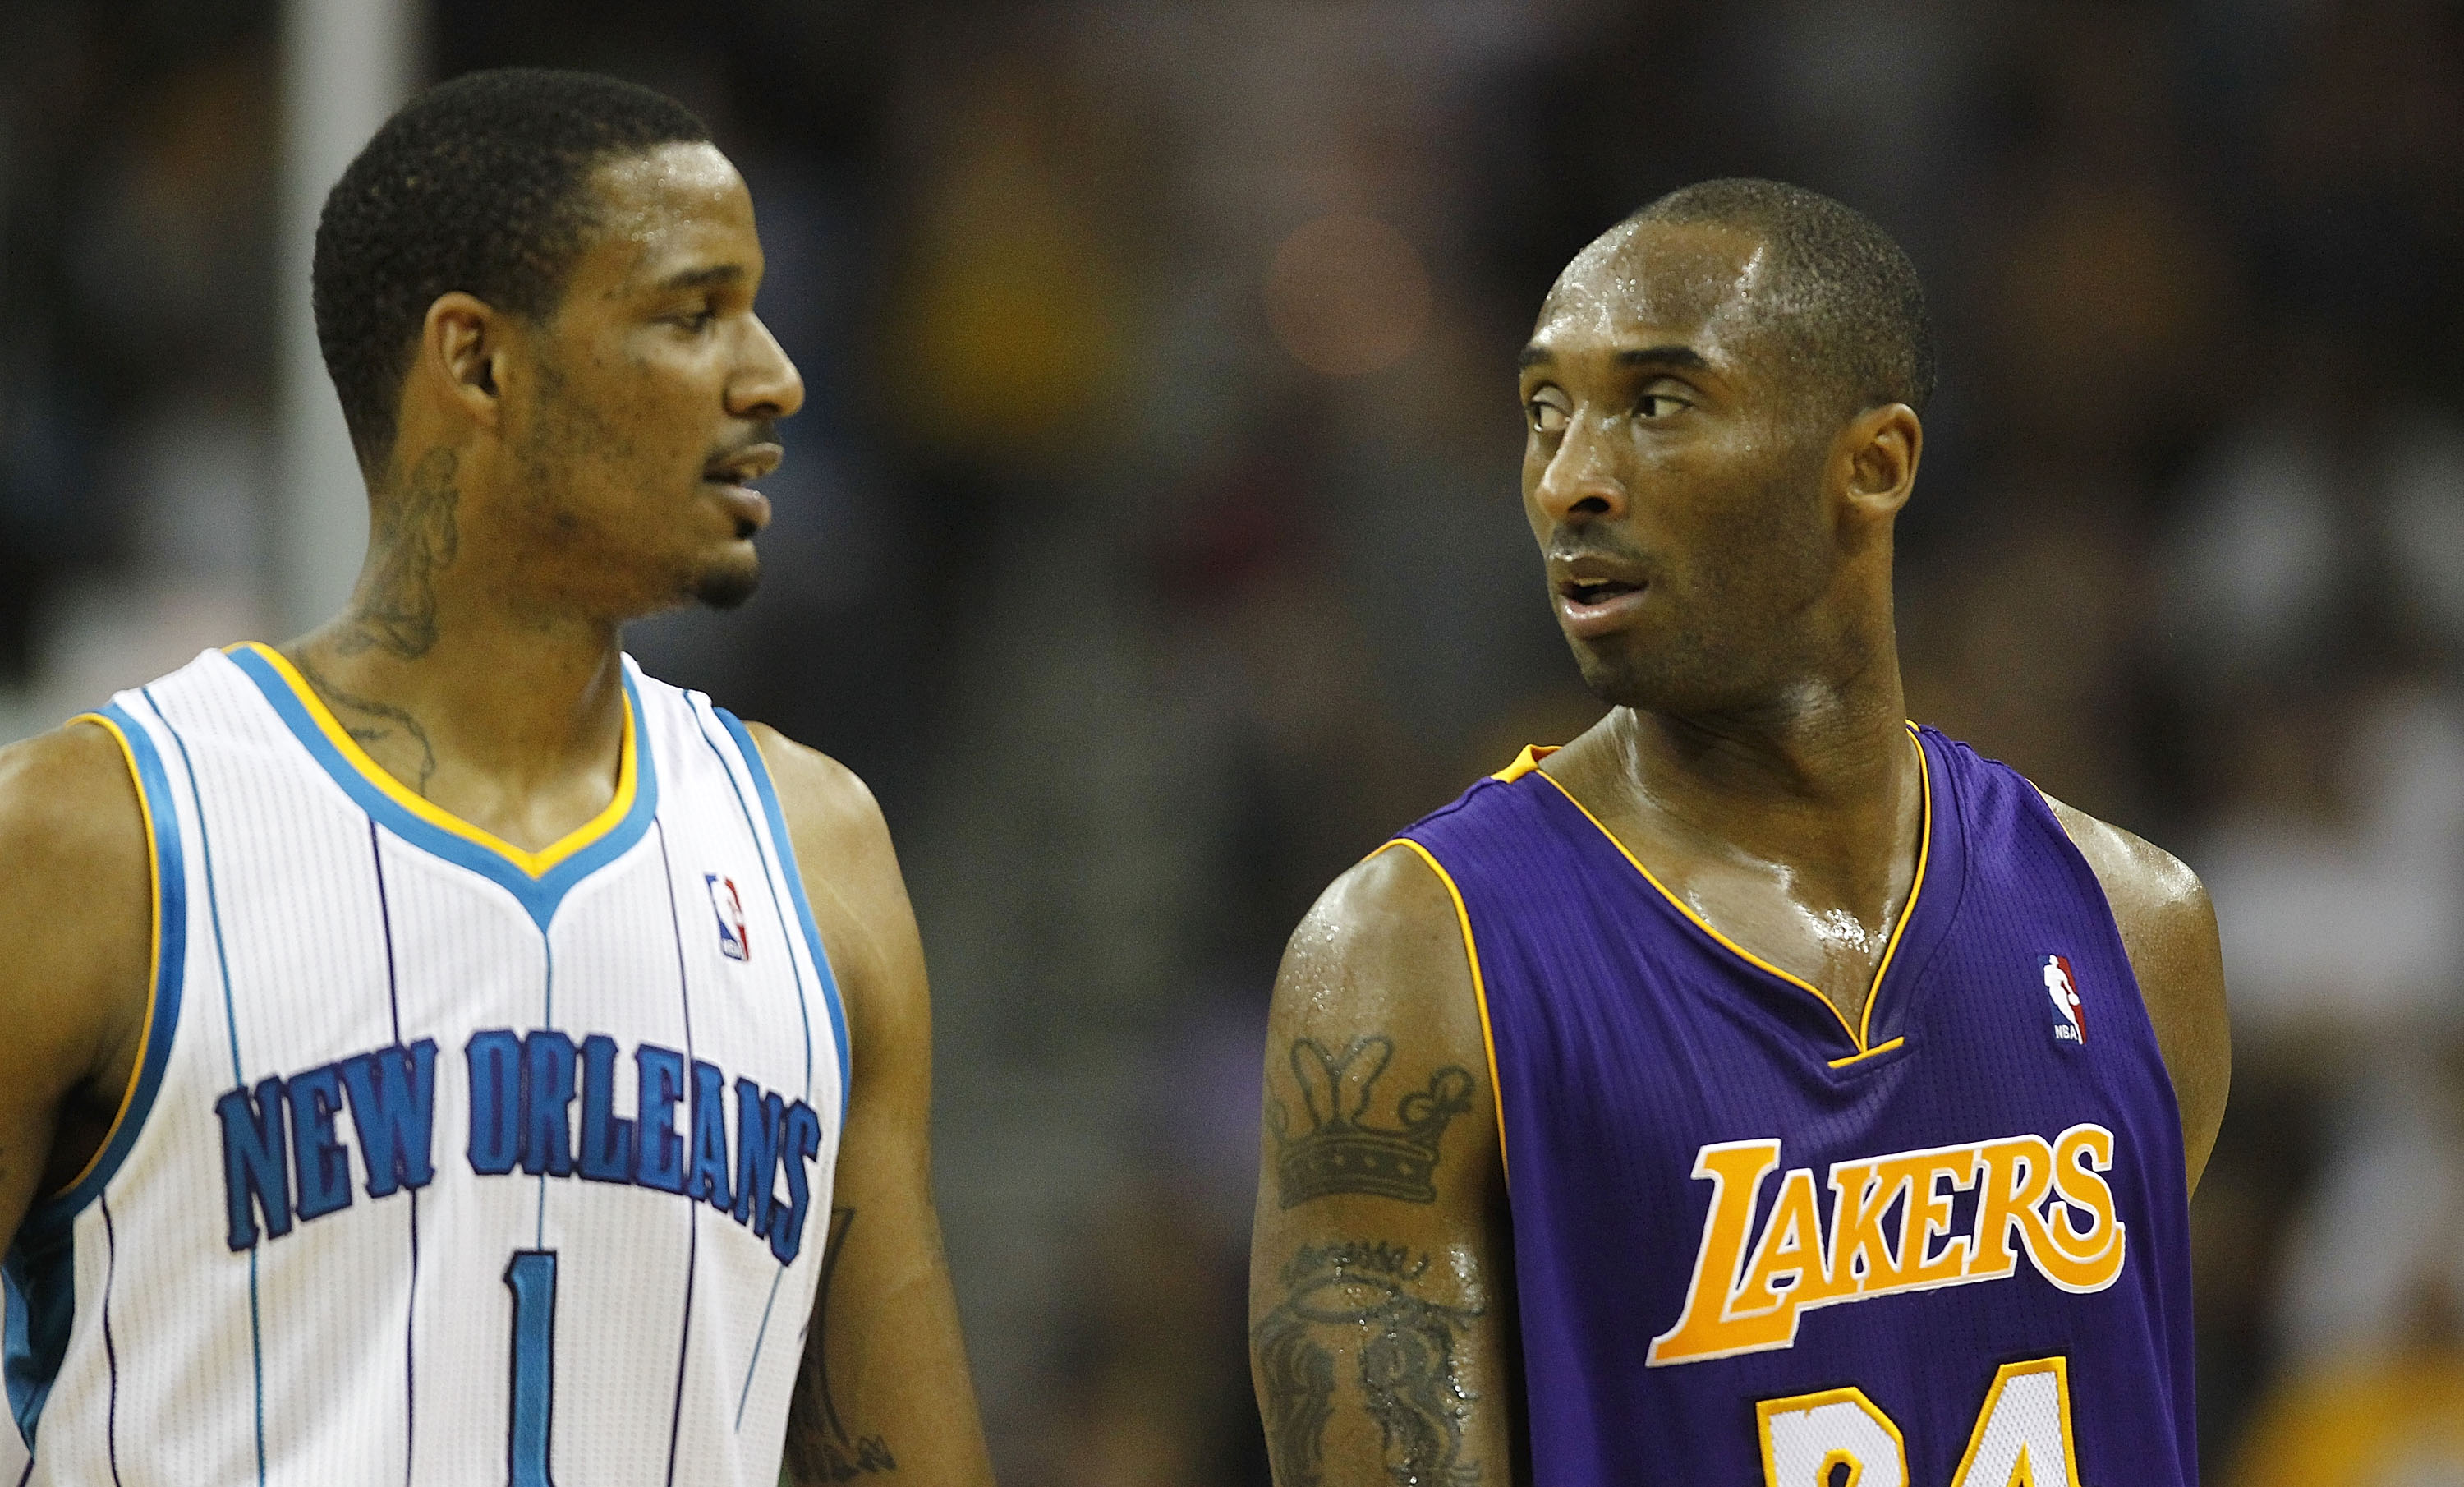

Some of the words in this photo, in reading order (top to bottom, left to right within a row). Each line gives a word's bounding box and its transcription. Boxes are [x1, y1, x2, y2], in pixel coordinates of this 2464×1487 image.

[214, 1038, 438, 1253] NEW
[464, 1029, 821, 1267] ORLEANS
[2054, 1024, 2078, 1040] NBA
[1645, 1122, 2126, 1367] LAKERS
[503, 1249, 558, 1487] 1
